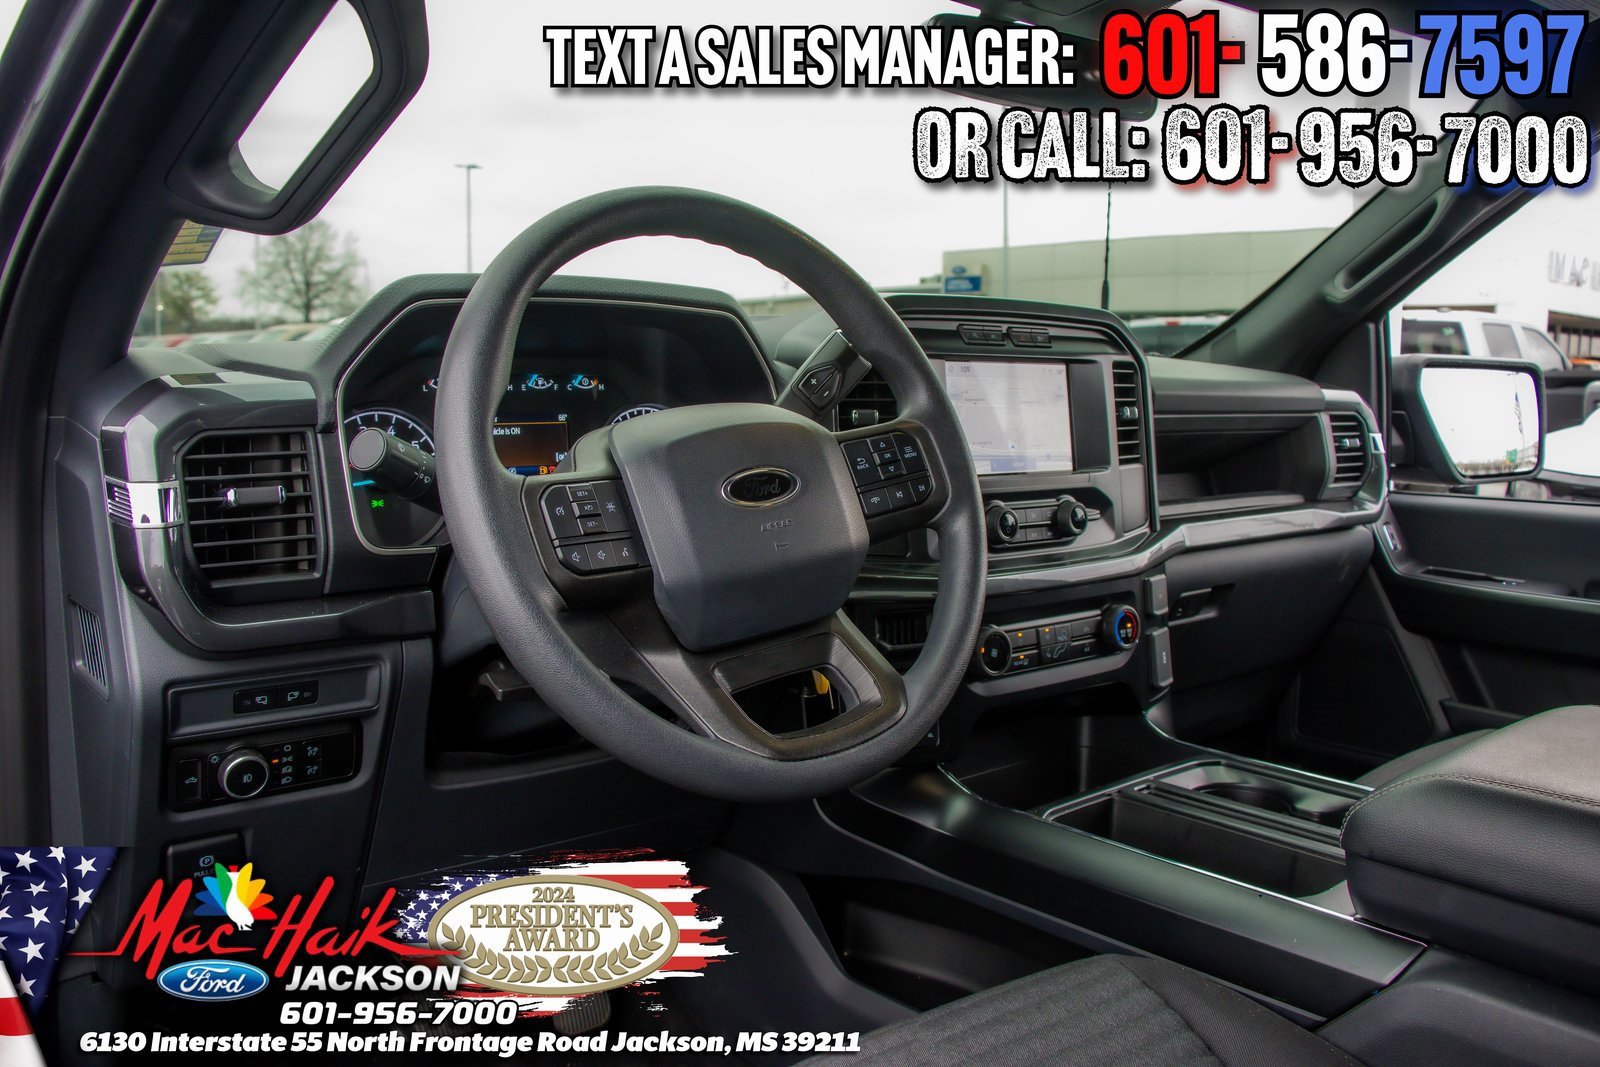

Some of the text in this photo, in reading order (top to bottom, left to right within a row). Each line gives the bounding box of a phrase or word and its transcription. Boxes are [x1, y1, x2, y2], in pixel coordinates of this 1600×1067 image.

[422, 384, 428, 392] L
[387, 425, 396, 436] 4
[510, 427, 520, 435] ON
[411, 440, 420, 450] 5
[856, 463, 870, 471] BACK
[743, 475, 781, 499] Ford
